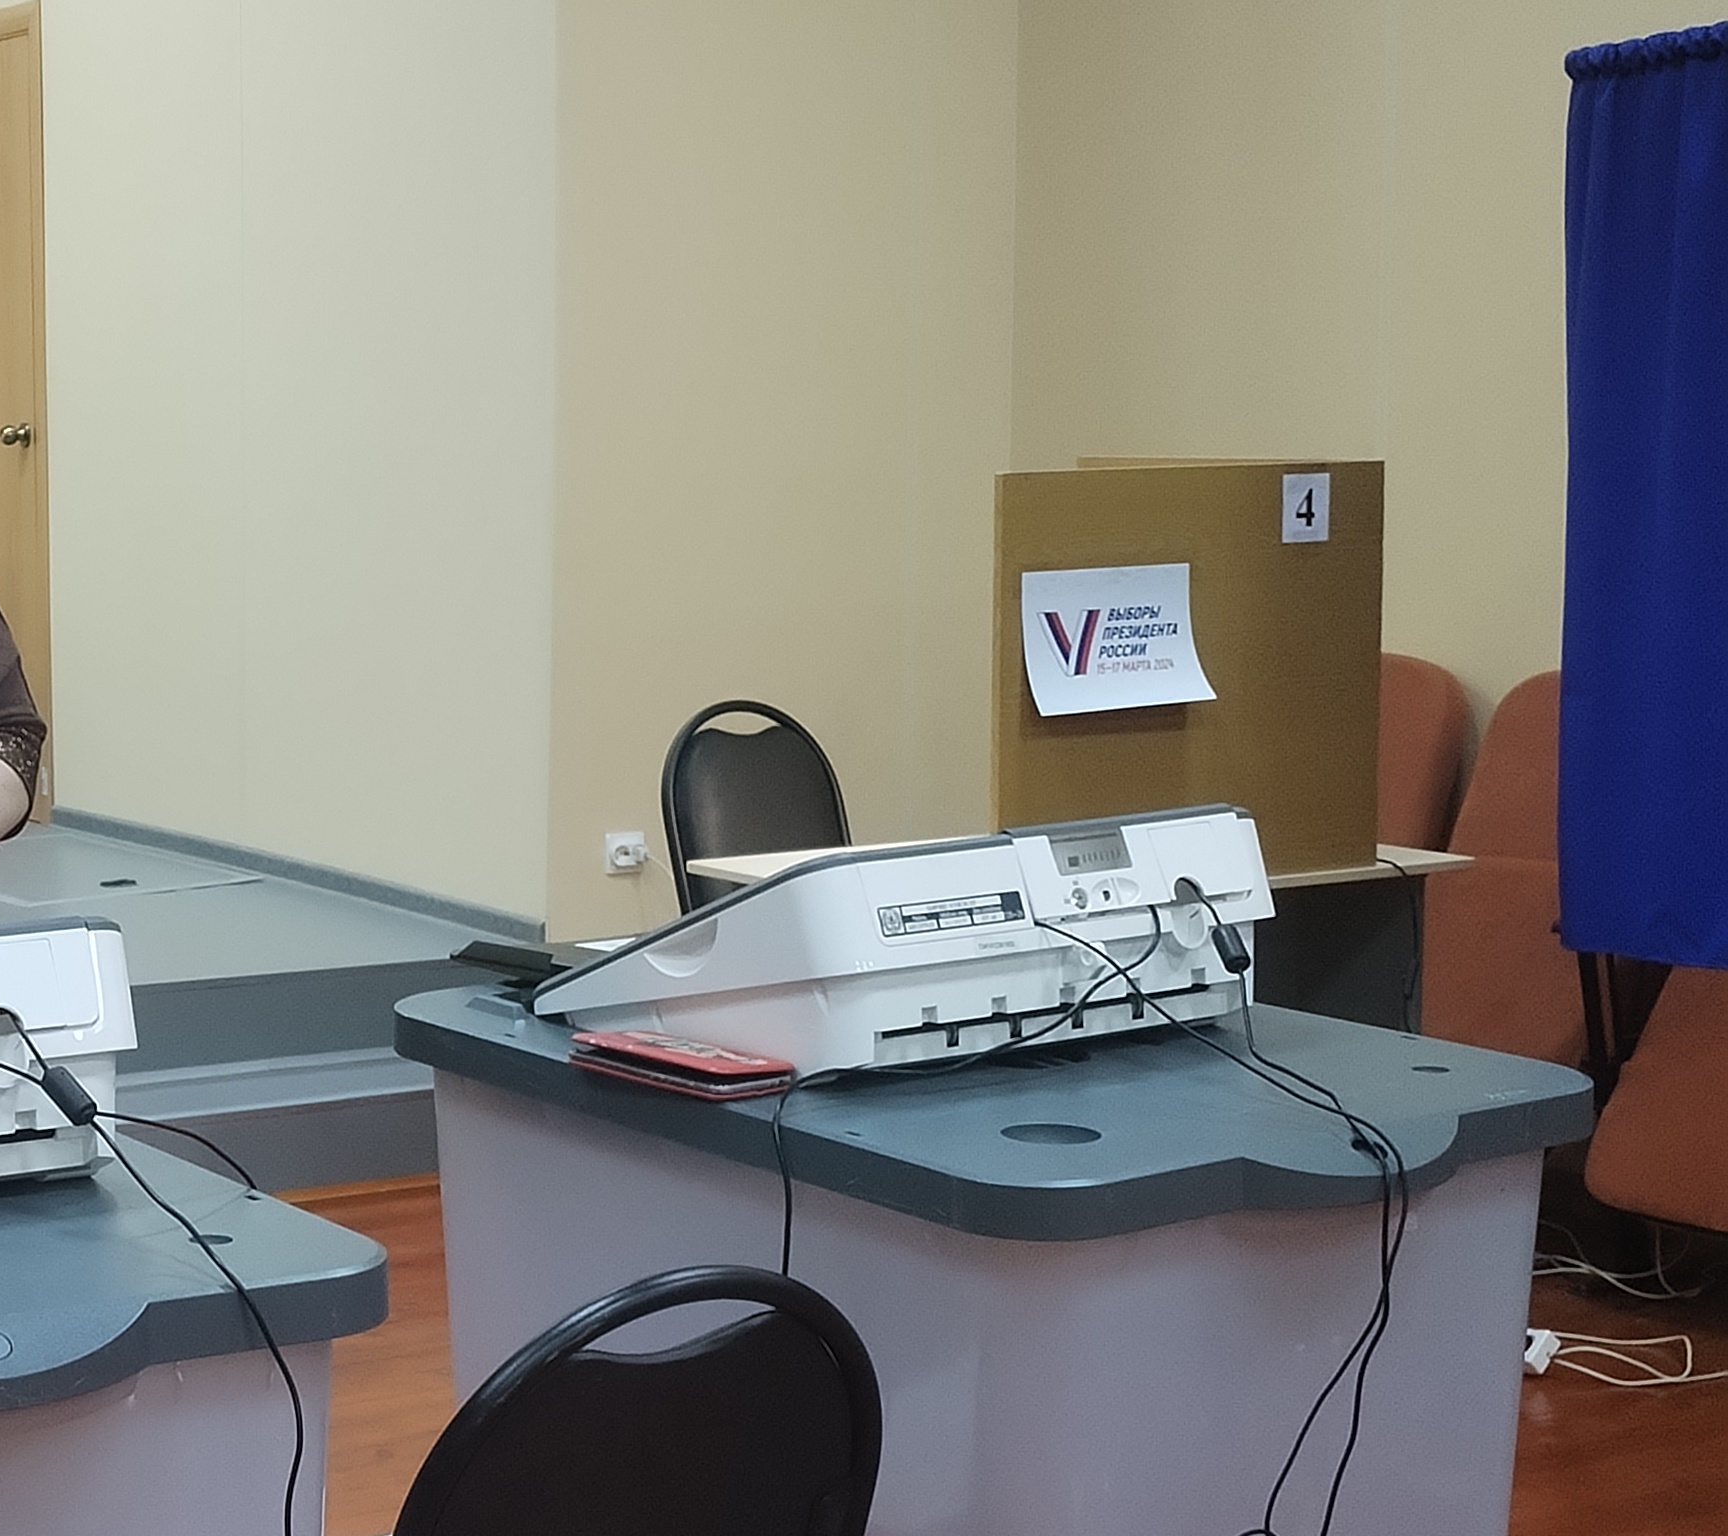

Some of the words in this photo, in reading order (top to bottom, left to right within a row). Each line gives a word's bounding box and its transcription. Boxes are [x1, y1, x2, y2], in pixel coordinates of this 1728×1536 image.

[1296, 488, 1315, 527] 4
[1107, 605, 1161, 622] ВЫБОРЫ
[1102, 622, 1178, 640] ПРЕЗИДЕНТА
[1098, 643, 1148, 659] РОССИИ
[1122, 660, 1151, 672] МАРТА
